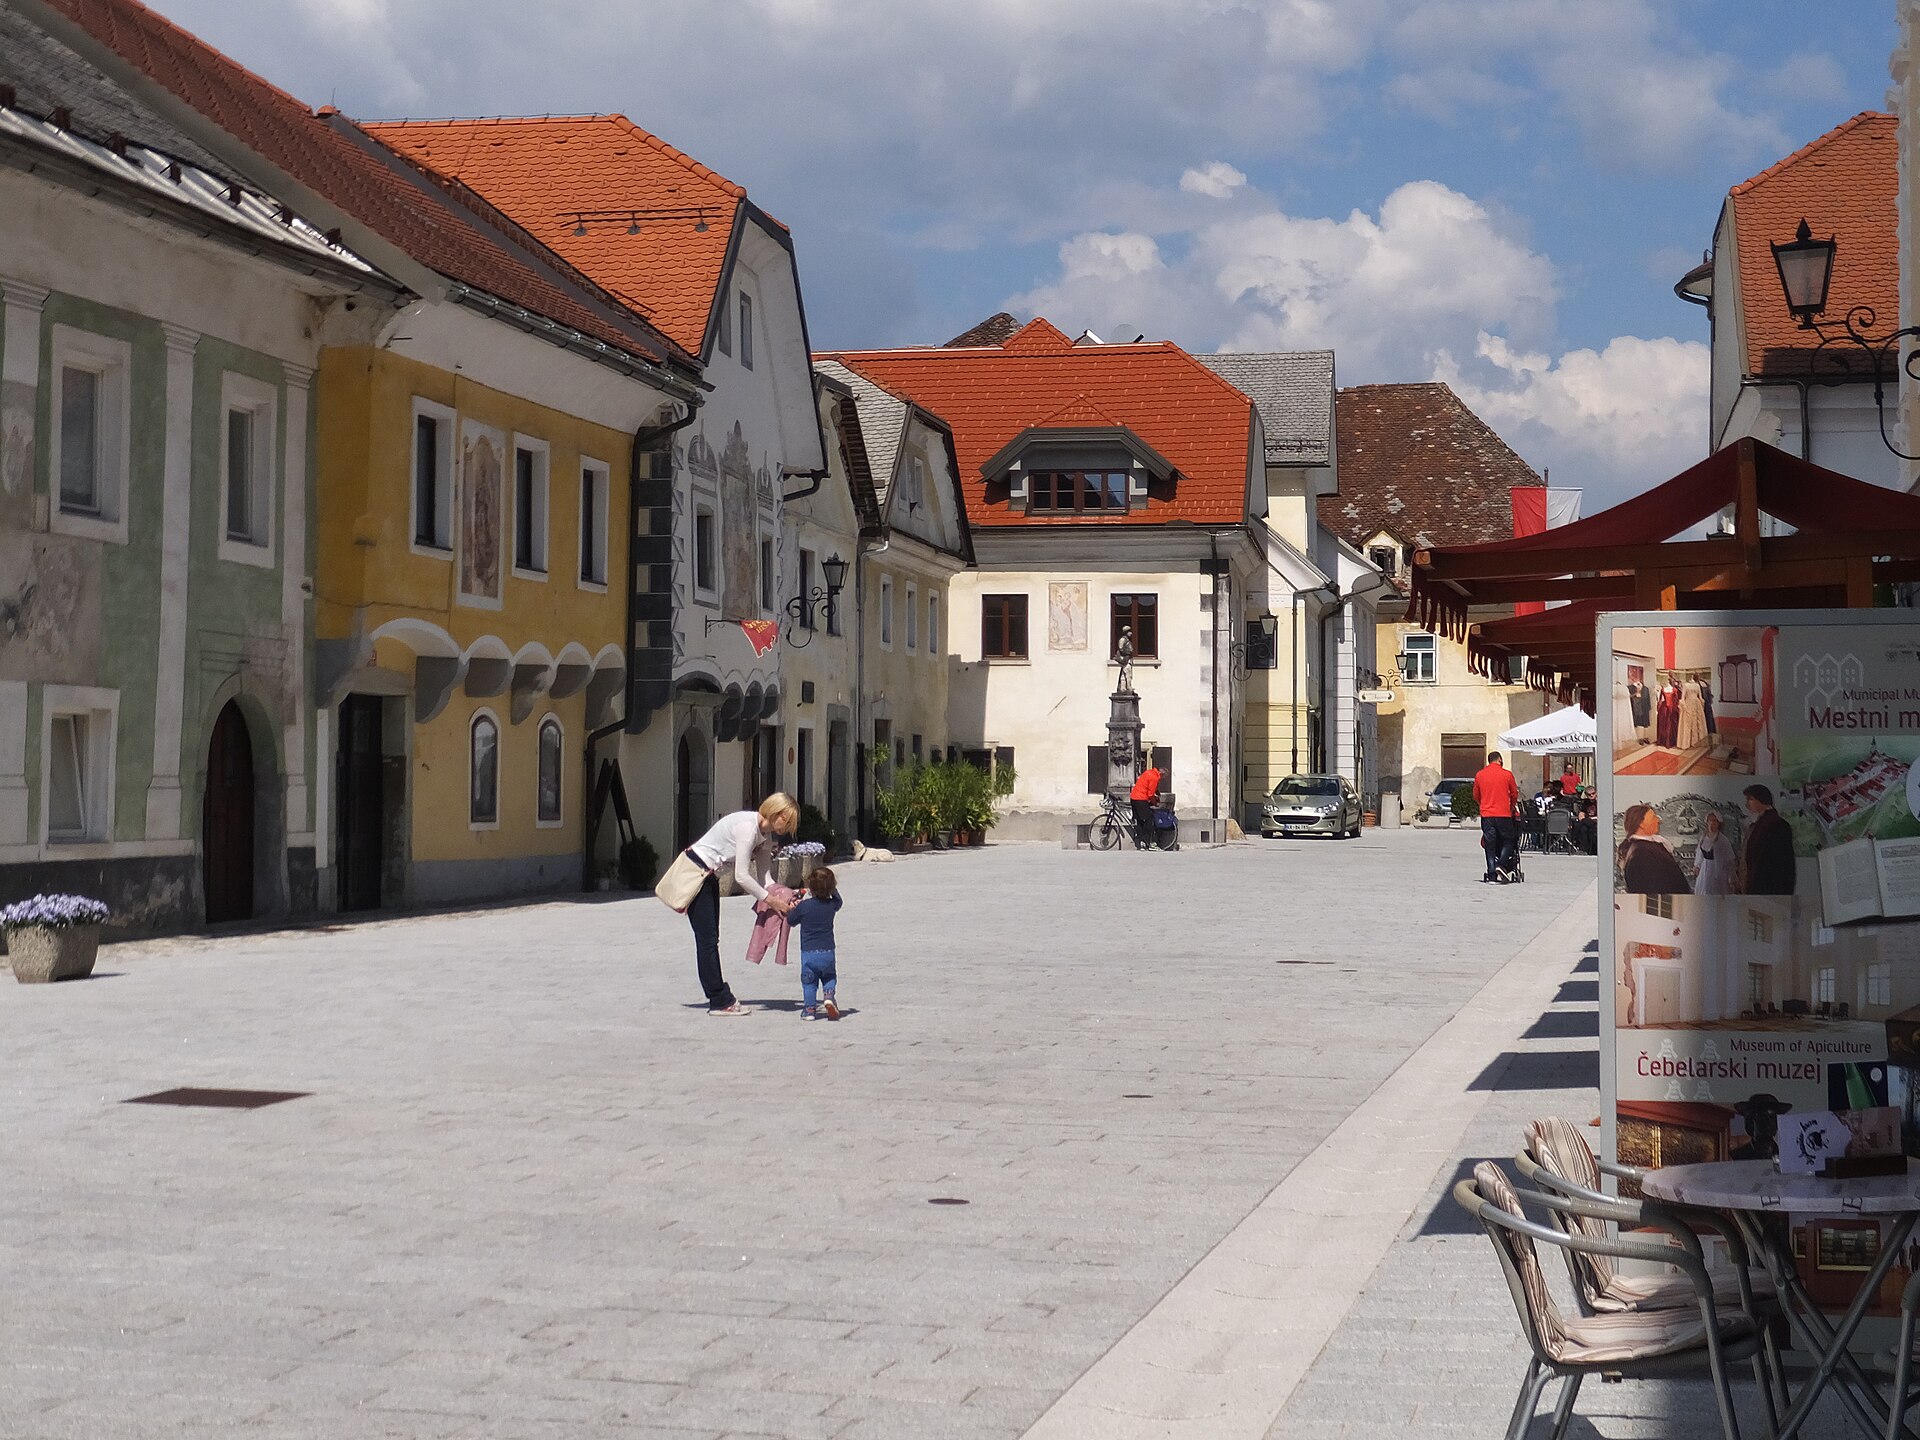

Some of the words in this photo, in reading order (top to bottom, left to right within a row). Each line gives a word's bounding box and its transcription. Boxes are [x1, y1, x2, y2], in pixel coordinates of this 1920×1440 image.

[1842, 688, 1900, 702] Municipal
[1809, 705, 1888, 728] Mestni
[1519, 737, 1554, 746] KAVARNA
[1730, 1039, 1786, 1052] Museum
[1790, 1040, 1803, 1052] of
[1807, 1039, 1872, 1054] Apiculture
[1637, 1051, 1747, 1079] Čebelarski
[1756, 1058, 1821, 1084] muzej
